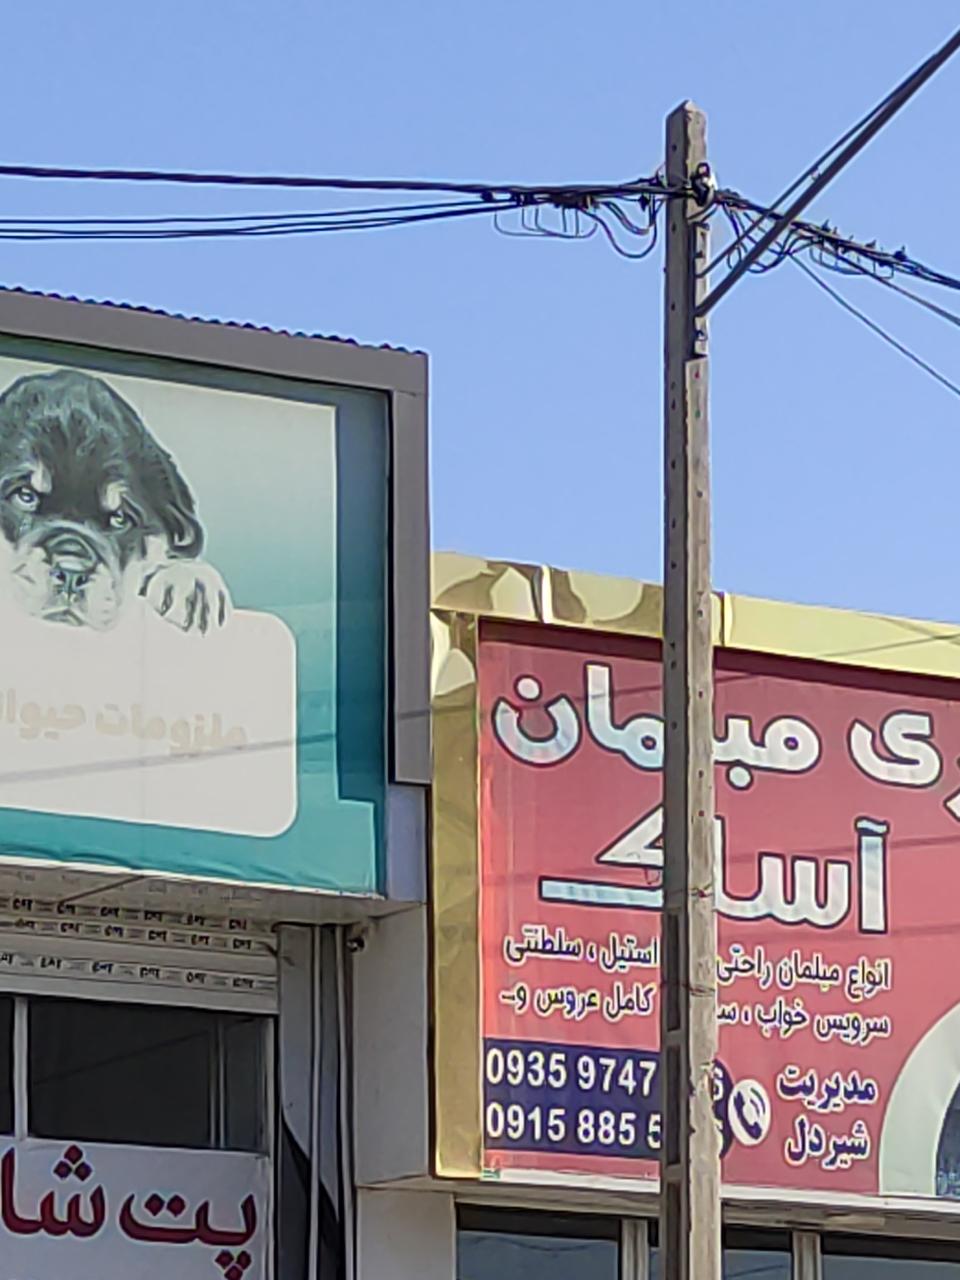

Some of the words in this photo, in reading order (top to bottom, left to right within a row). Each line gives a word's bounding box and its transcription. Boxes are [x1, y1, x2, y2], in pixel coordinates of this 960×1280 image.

[0, 687, 87, 740] حیوا
[491, 660, 821, 790] مبمان
[505, 926, 582, 963] سلطنتی
[601, 934, 658, 971] استیل
[716, 946, 771, 987] راحتی
[778, 951, 840, 988] مبلمان
[847, 958, 890, 999] انواع
[536, 987, 599, 1018] عروس
[605, 984, 654, 1019] کامل
[756, 999, 808, 1036] خواب
[815, 1014, 889, 1043] سرویس
[486, 1048, 567, 1088] 0935
[779, 1067, 877, 1110] مدیریت
[486, 1101, 566, 1142] 0915
[0, 1145, 106, 1238] شا
